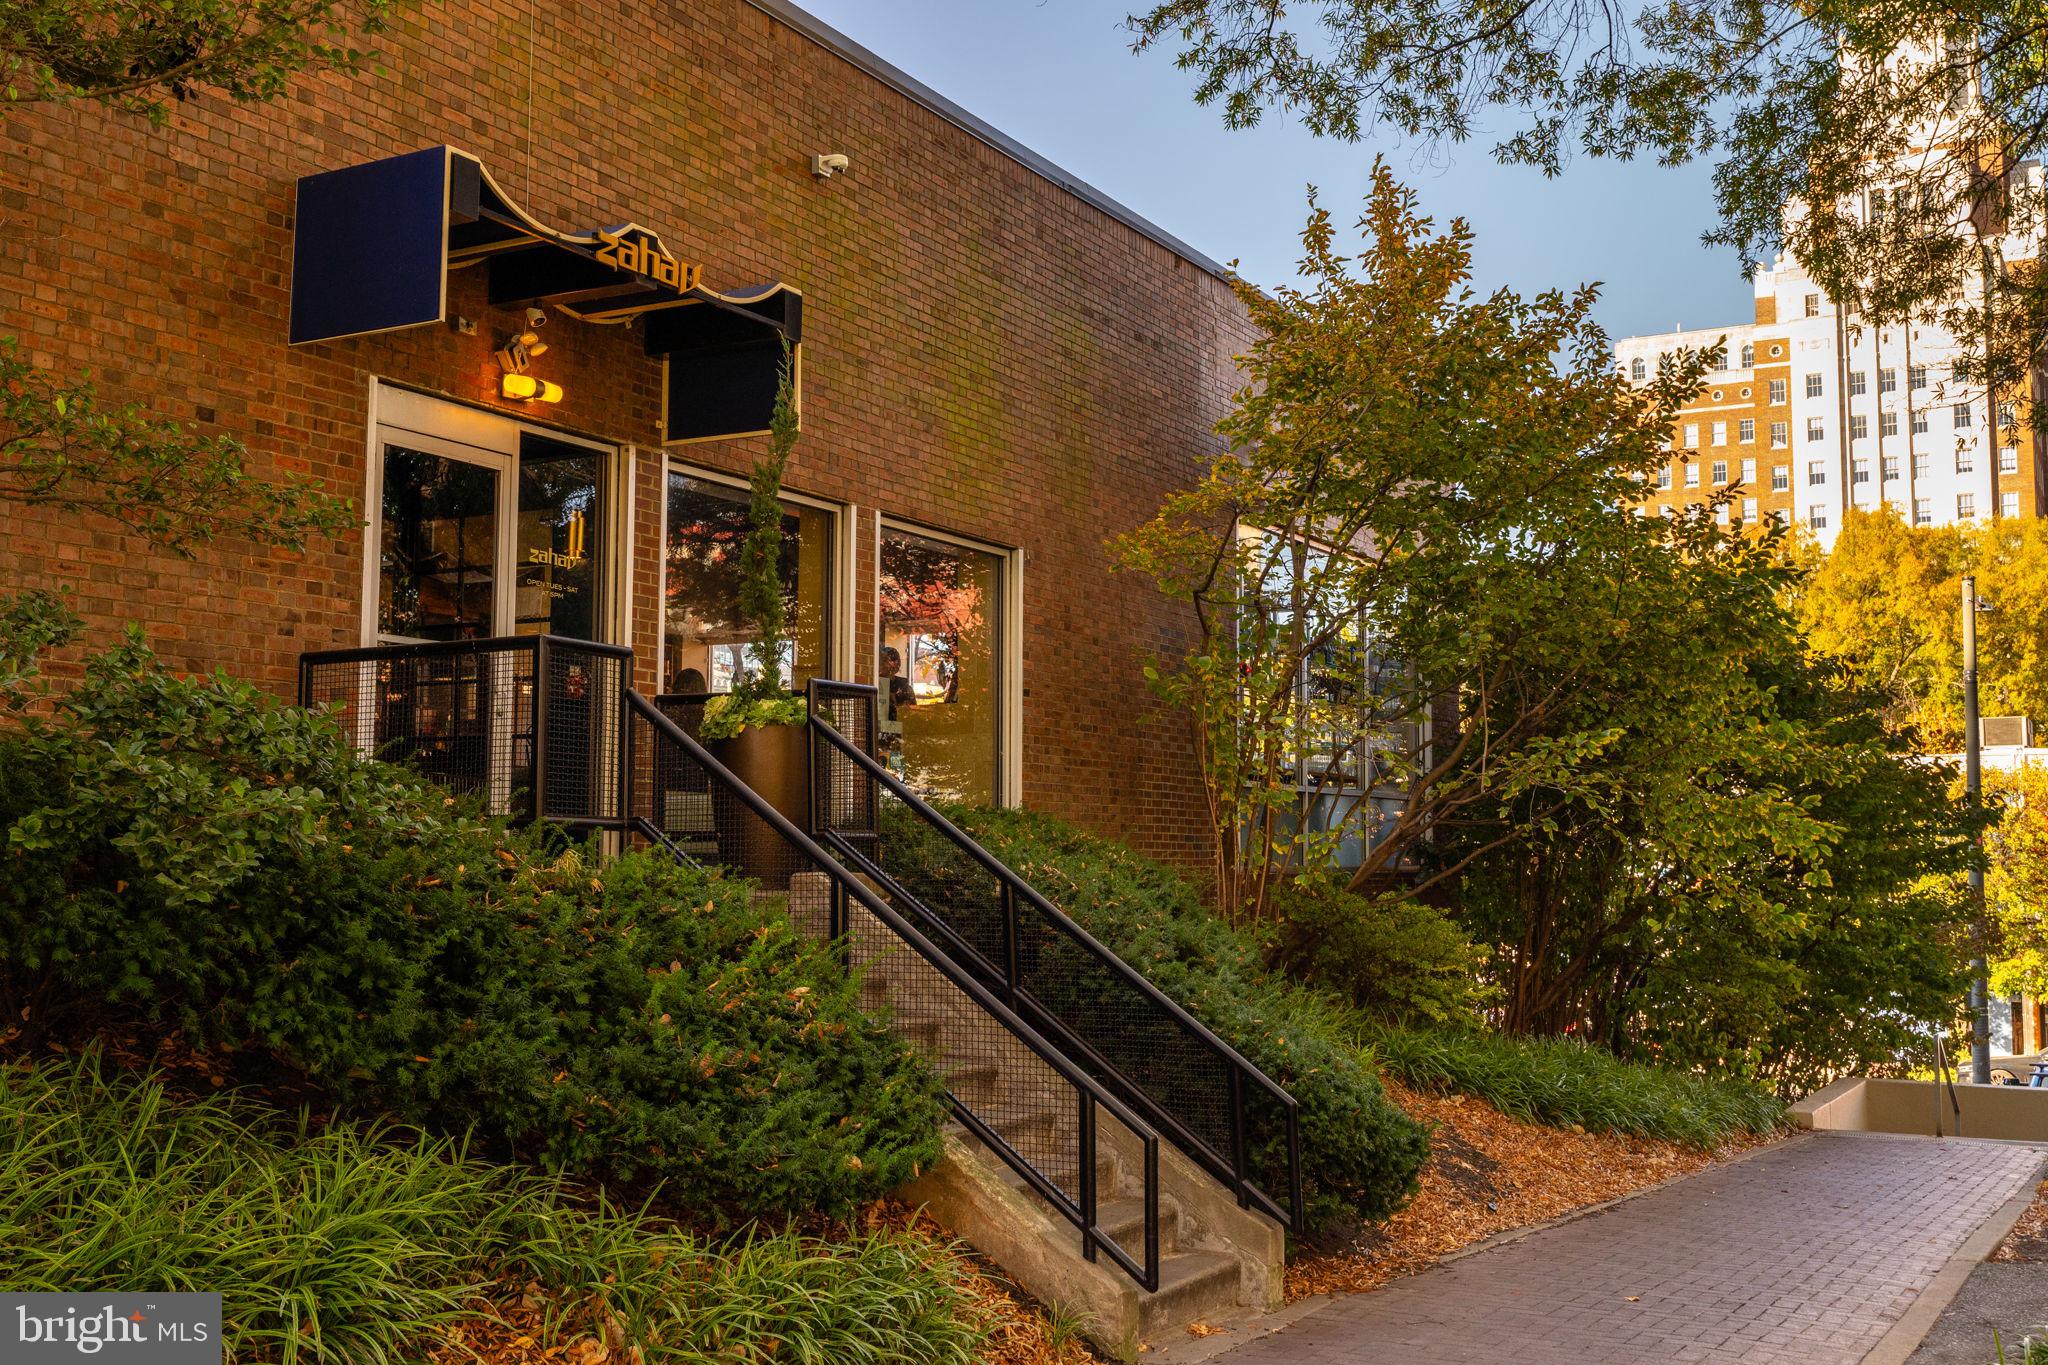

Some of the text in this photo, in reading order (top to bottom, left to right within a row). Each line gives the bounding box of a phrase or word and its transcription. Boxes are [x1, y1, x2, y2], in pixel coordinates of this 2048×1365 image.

[596, 228, 703, 294] zahav
[526, 579, 546, 587] OPEN
[546, 583, 563, 591] TUES
[566, 585, 579, 593] SAT
